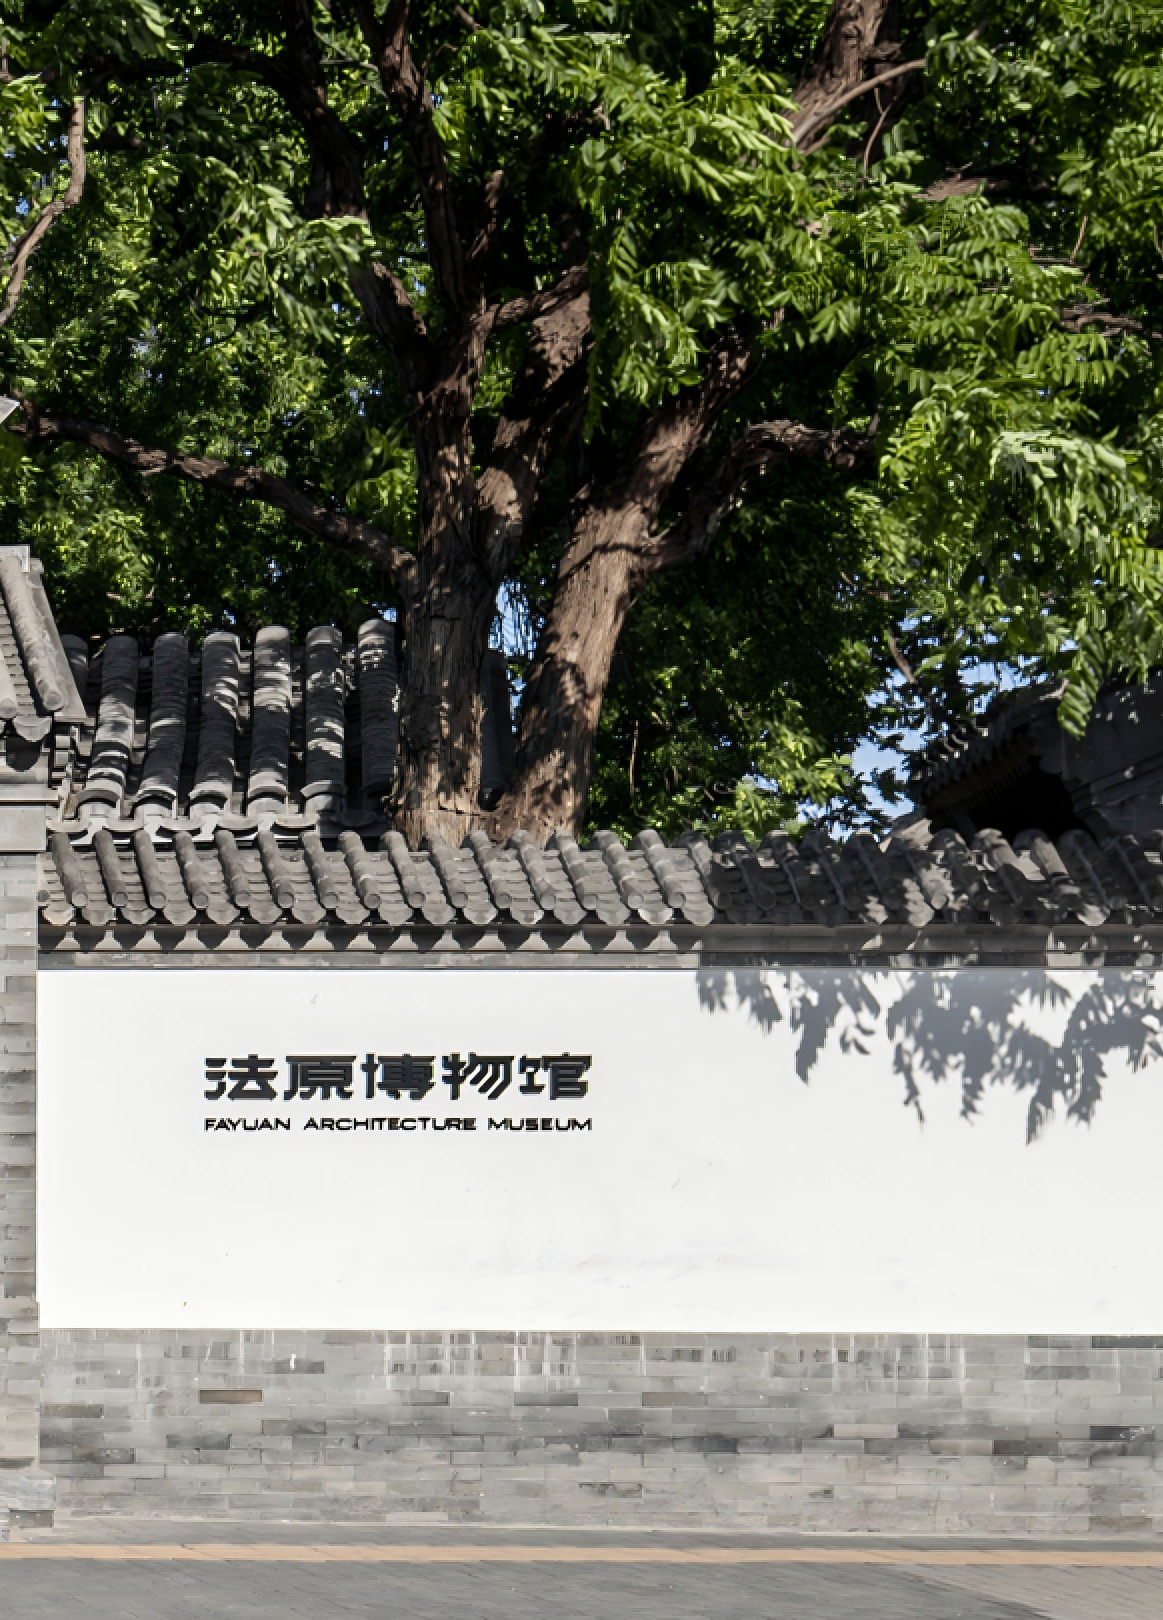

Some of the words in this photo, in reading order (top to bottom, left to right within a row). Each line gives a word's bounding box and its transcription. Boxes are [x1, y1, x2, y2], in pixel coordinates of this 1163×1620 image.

[203, 1051, 593, 1101] 法原博物馆
[203, 1117, 291, 1131] FAYUAN
[303, 1117, 477, 1131] ARCHITECTURE
[487, 1117, 593, 1131] MUSEUM
